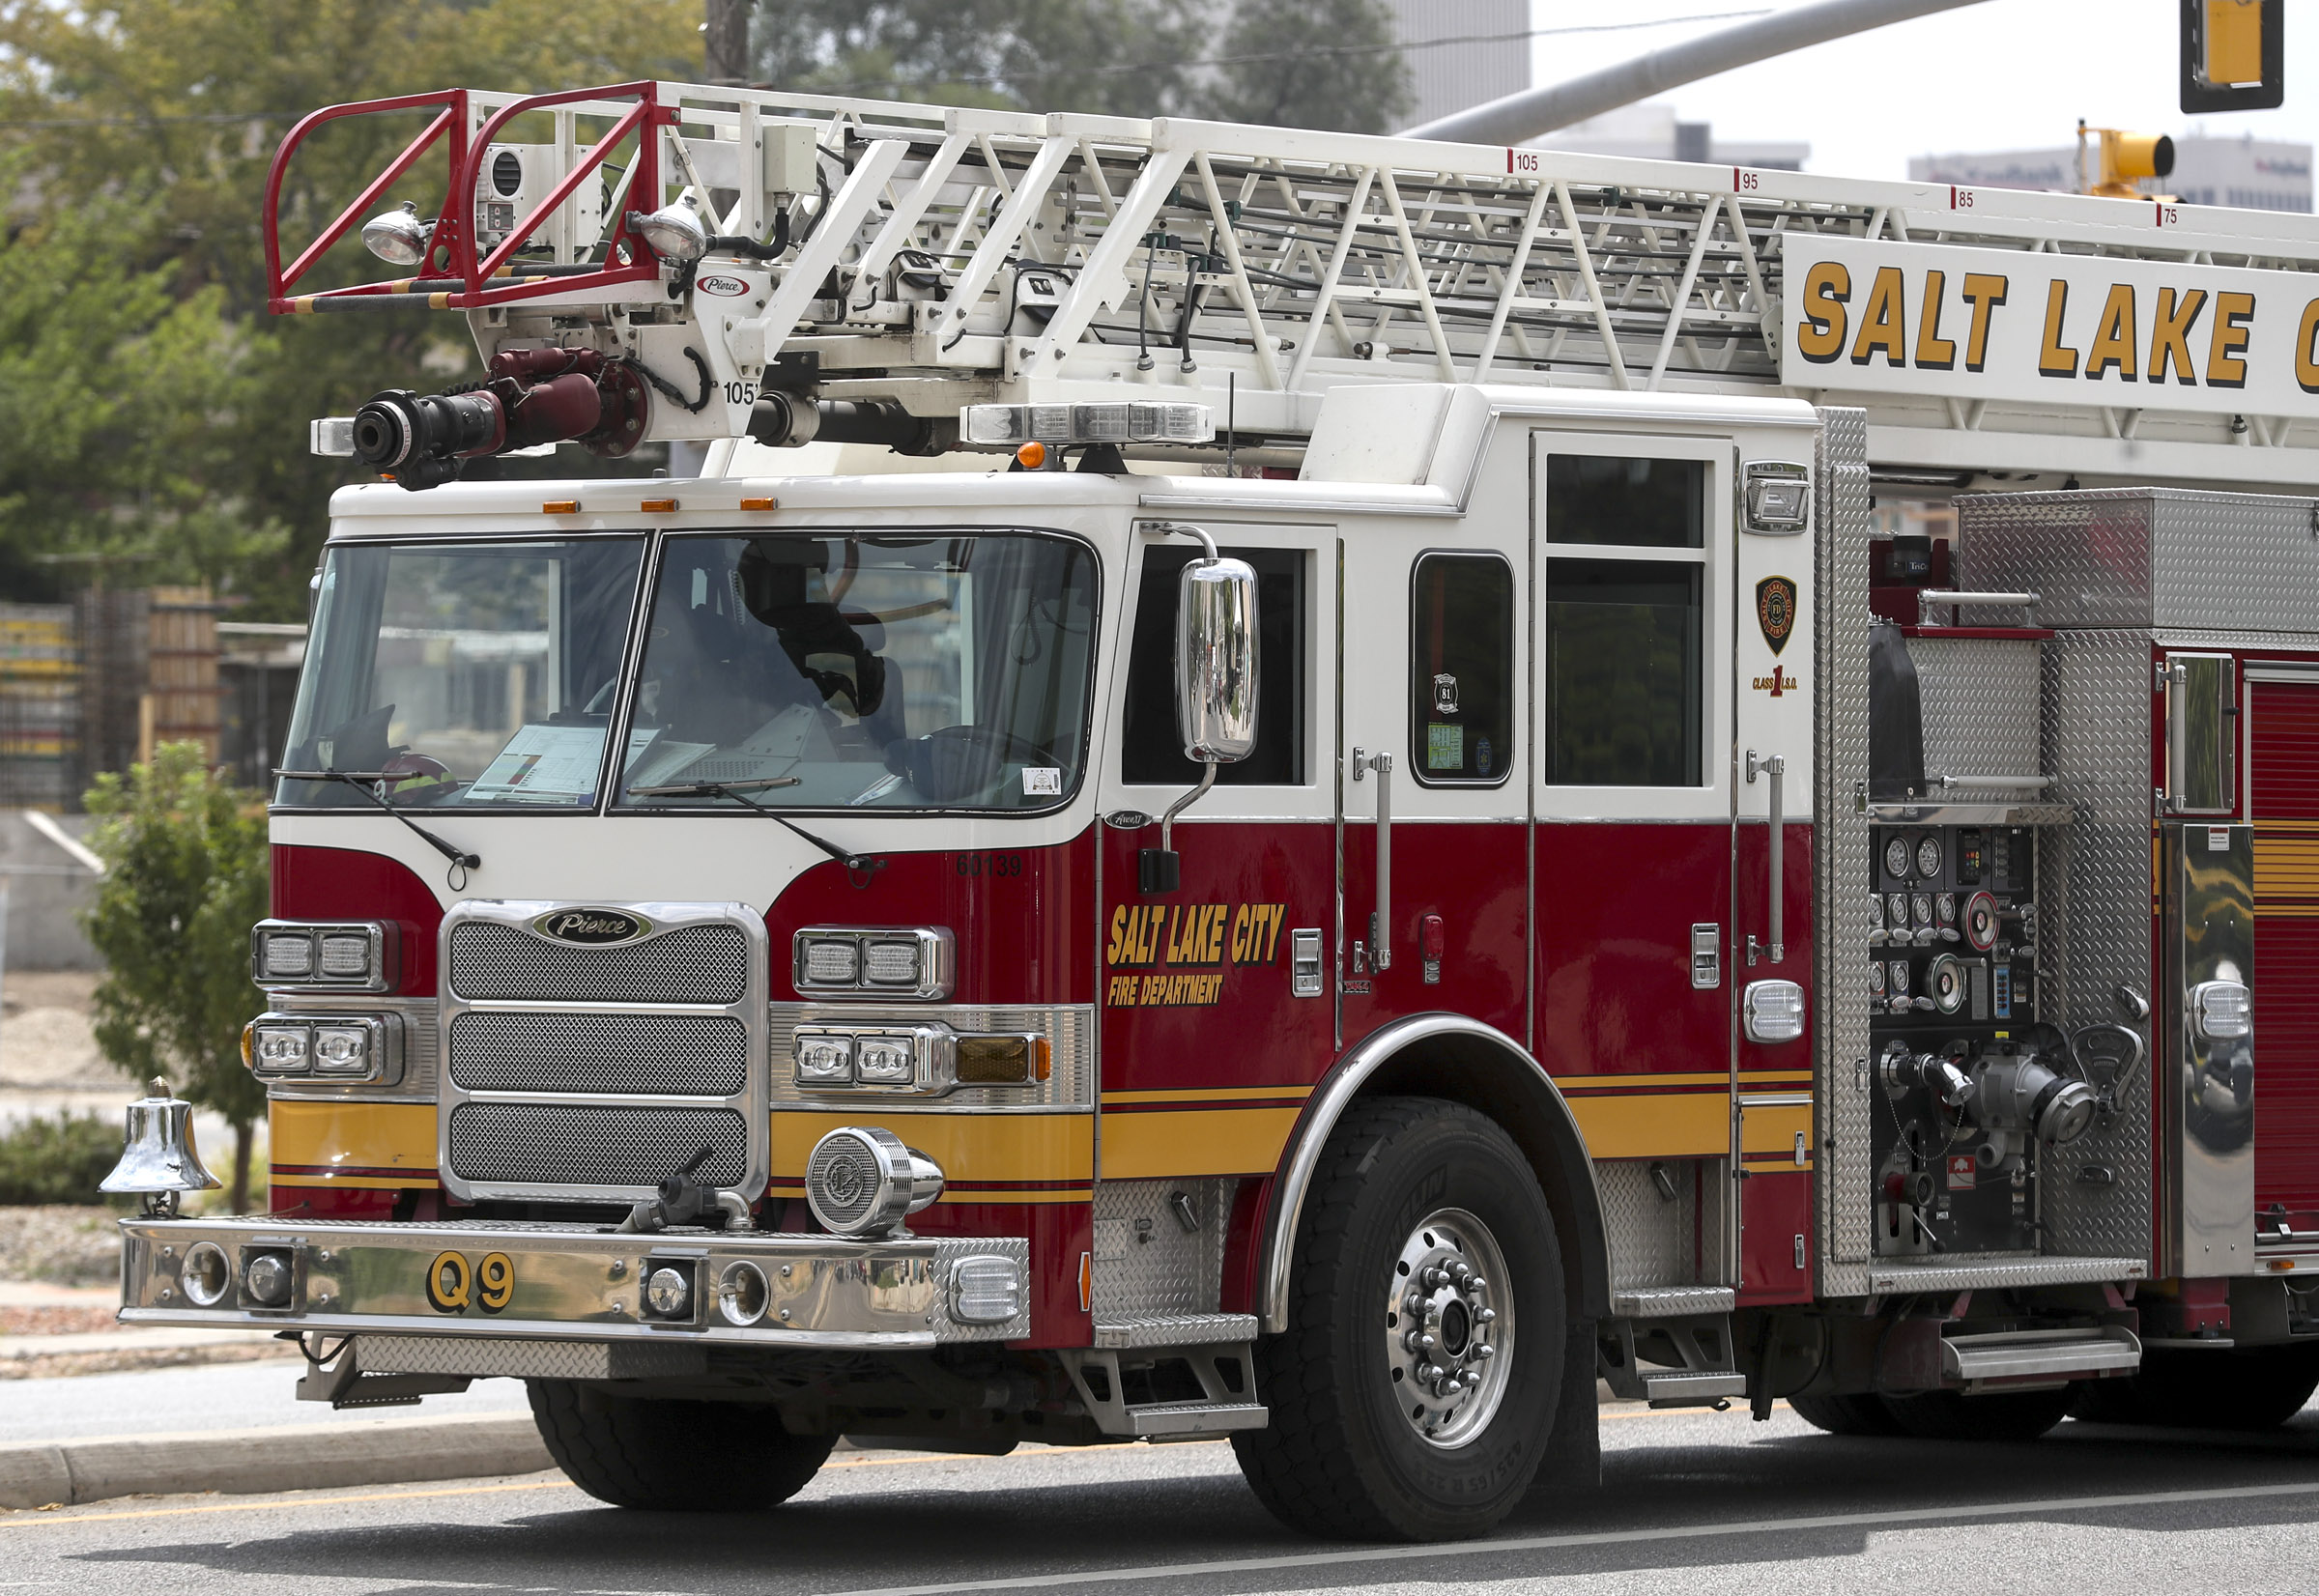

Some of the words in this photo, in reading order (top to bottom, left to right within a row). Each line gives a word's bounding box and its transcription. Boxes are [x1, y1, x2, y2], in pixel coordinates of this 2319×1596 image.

[1517, 155, 1538, 171] 105
[1743, 173, 1759, 190] 95
[1959, 191, 1973, 208] 85
[2164, 209, 2177, 224] 75
[707, 278, 739, 292] Pierce
[1797, 261, 2009, 373] SALT
[2038, 278, 2256, 389] LAKE
[1753, 677, 1773, 690] CLASS
[1770, 665, 1783, 698] 1
[1442, 688, 1450, 699] 81
[957, 854, 1021, 876] 60139
[557, 913, 628, 935] Pierce
[1107, 903, 1166, 969] SALT
[1165, 903, 1230, 967] LAKE
[1231, 902, 1288, 966] CITY
[1107, 975, 1141, 1007] FIRE
[1139, 974, 1224, 1006] DEPARTMENT
[426, 1250, 515, 1315] Q9
